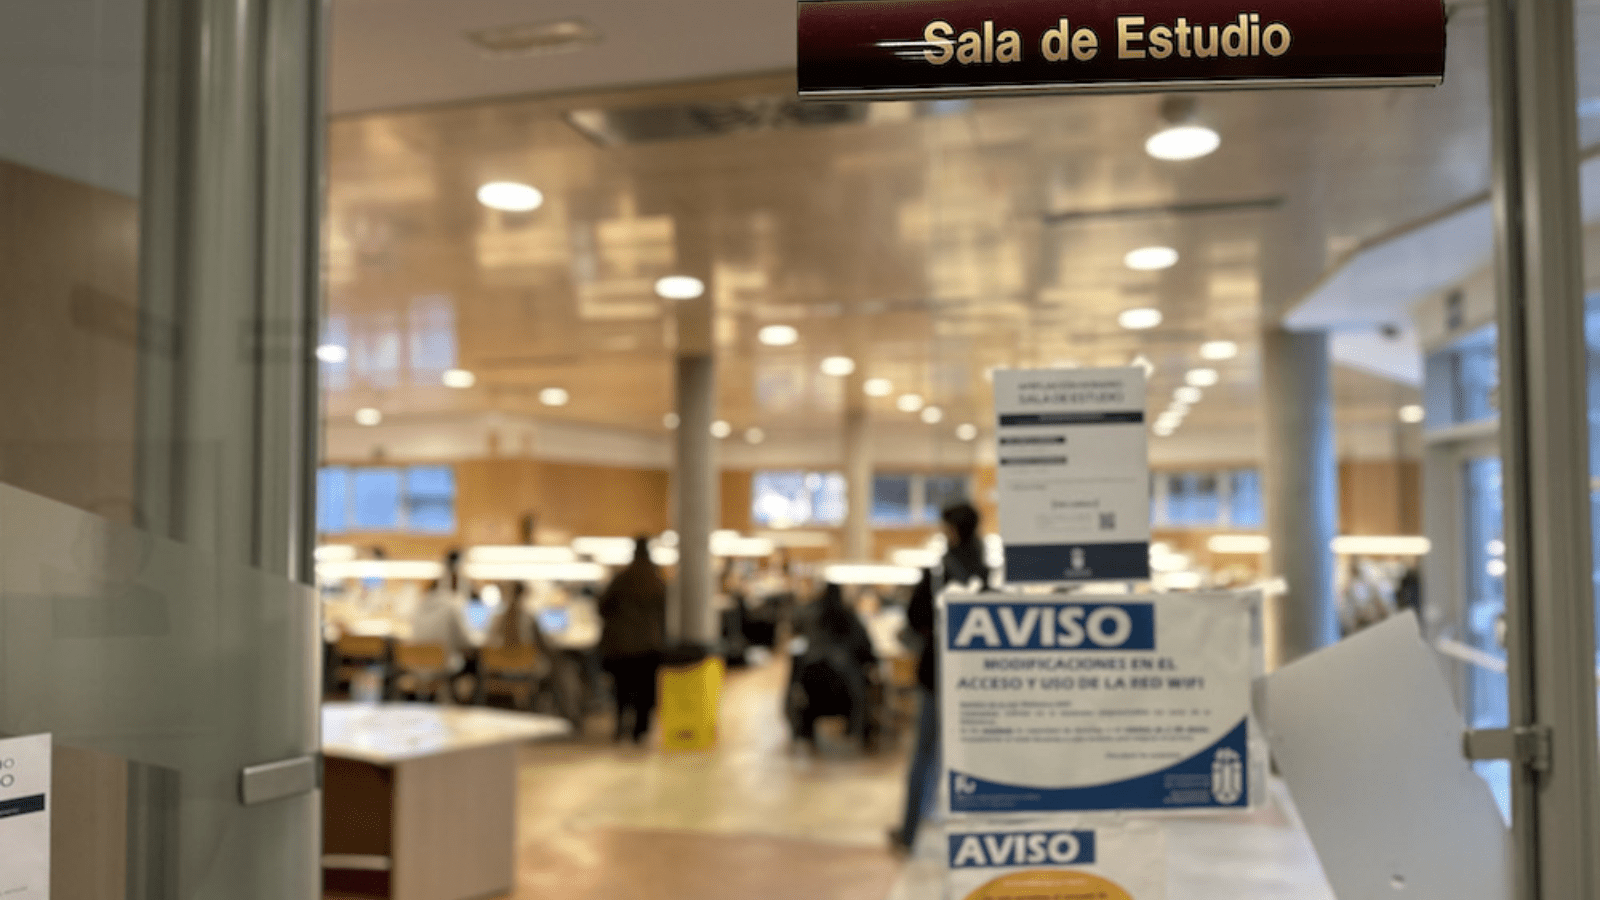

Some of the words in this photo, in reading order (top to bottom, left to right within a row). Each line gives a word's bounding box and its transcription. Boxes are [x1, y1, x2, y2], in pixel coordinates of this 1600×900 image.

[923, 20, 1021, 65] Sala
[1040, 18, 1098, 62] de
[1116, 13, 1292, 60] Estudio
[954, 606, 1132, 648] AVISO
[983, 657, 1126, 672] MODIFICACIONES
[1130, 657, 1154, 672] EN
[1157, 657, 1177, 672] EL
[957, 677, 1023, 691] ACCESO
[1026, 677, 1037, 690] Y
[1041, 677, 1075, 691] USO
[1078, 677, 1099, 690] DE
[1104, 677, 1127, 690] LA
[1130, 676, 1163, 690] RED
[953, 833, 1081, 866] AVISO
